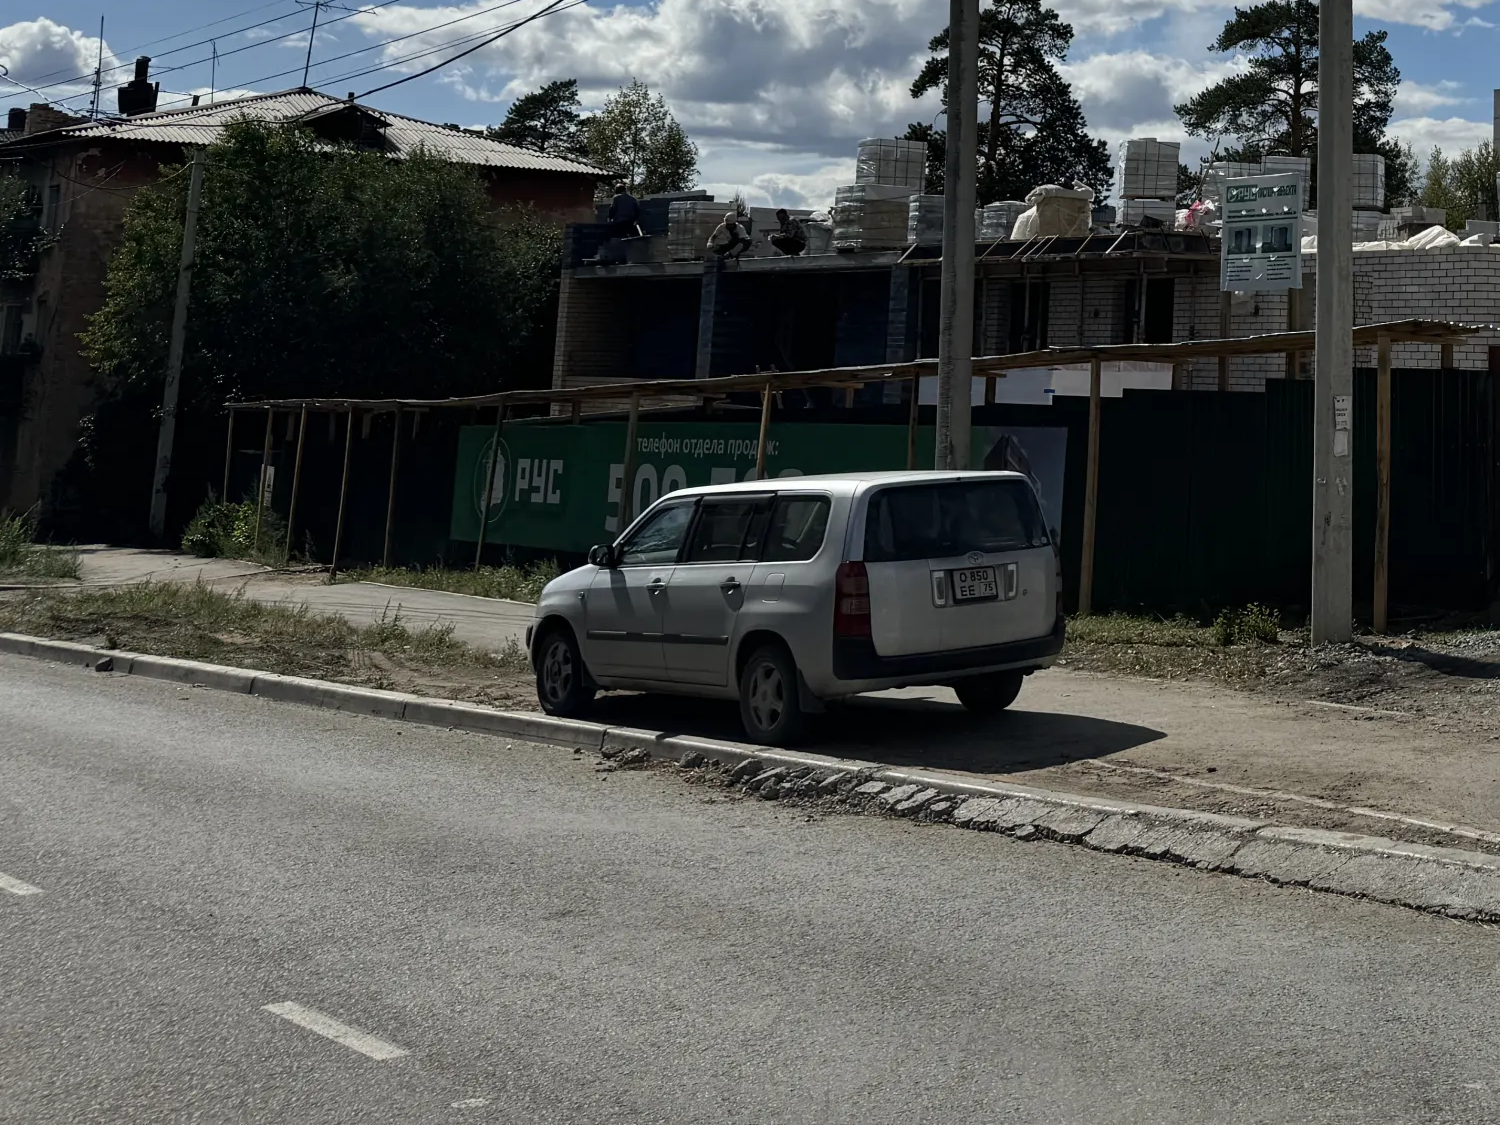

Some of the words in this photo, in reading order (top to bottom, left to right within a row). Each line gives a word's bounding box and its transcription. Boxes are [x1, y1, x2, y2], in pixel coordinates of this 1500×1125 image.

[637, 431, 680, 459] телефон
[683, 437, 724, 460] отдела
[727, 438, 780, 461] продж:
[514, 458, 564, 504] РУС
[970, 570, 989, 582] 850
[983, 583, 993, 592] 75
